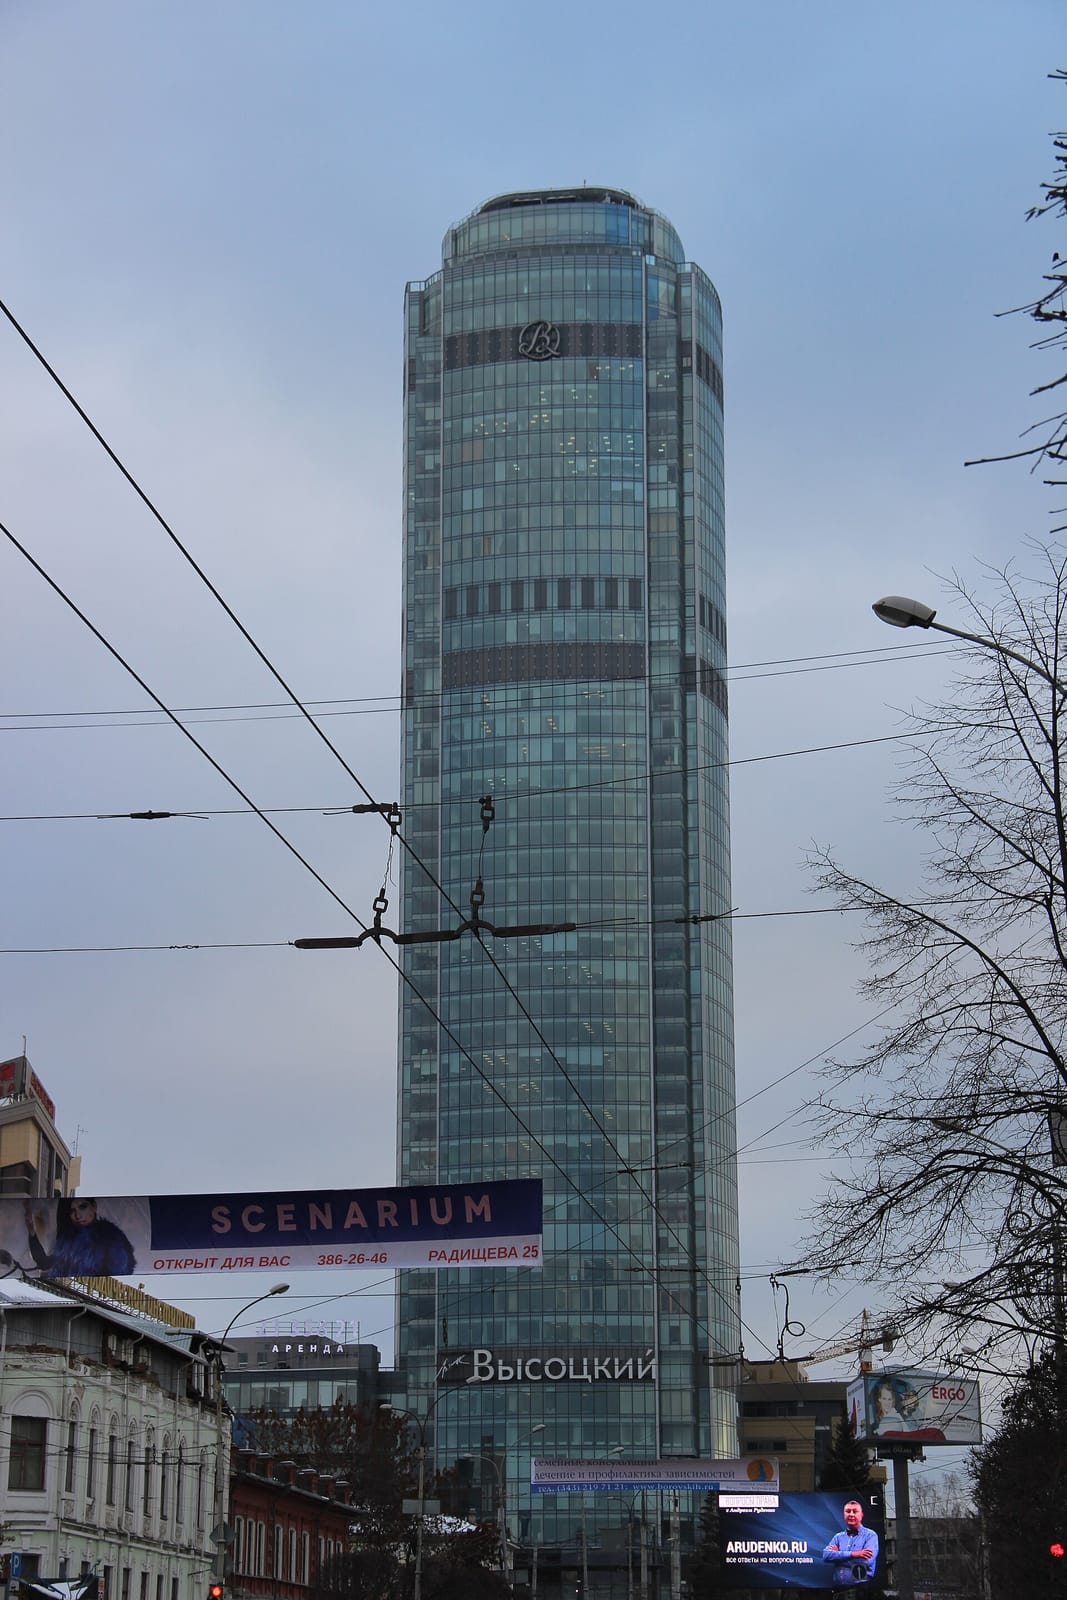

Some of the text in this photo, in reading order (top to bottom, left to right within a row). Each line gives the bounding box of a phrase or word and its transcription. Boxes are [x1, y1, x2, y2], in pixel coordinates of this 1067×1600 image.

[211, 1194, 493, 1234] SCENARIUM
[153, 1245, 539, 1270] ОТКРЫТ ДЛЯ ВАС 386-26-46 РАДИЩЕВА 25
[271, 1344, 344, 1355] АРЕНДА
[472, 1349, 657, 1383] Высоцкий
[932, 1387, 965, 1401] ERGO
[577, 1471, 586, 1479] и
[588, 1469, 662, 1481] профилактика
[665, 1469, 735, 1479] зависимостей
[726, 1541, 808, 1553] ARUDENKO.RU
